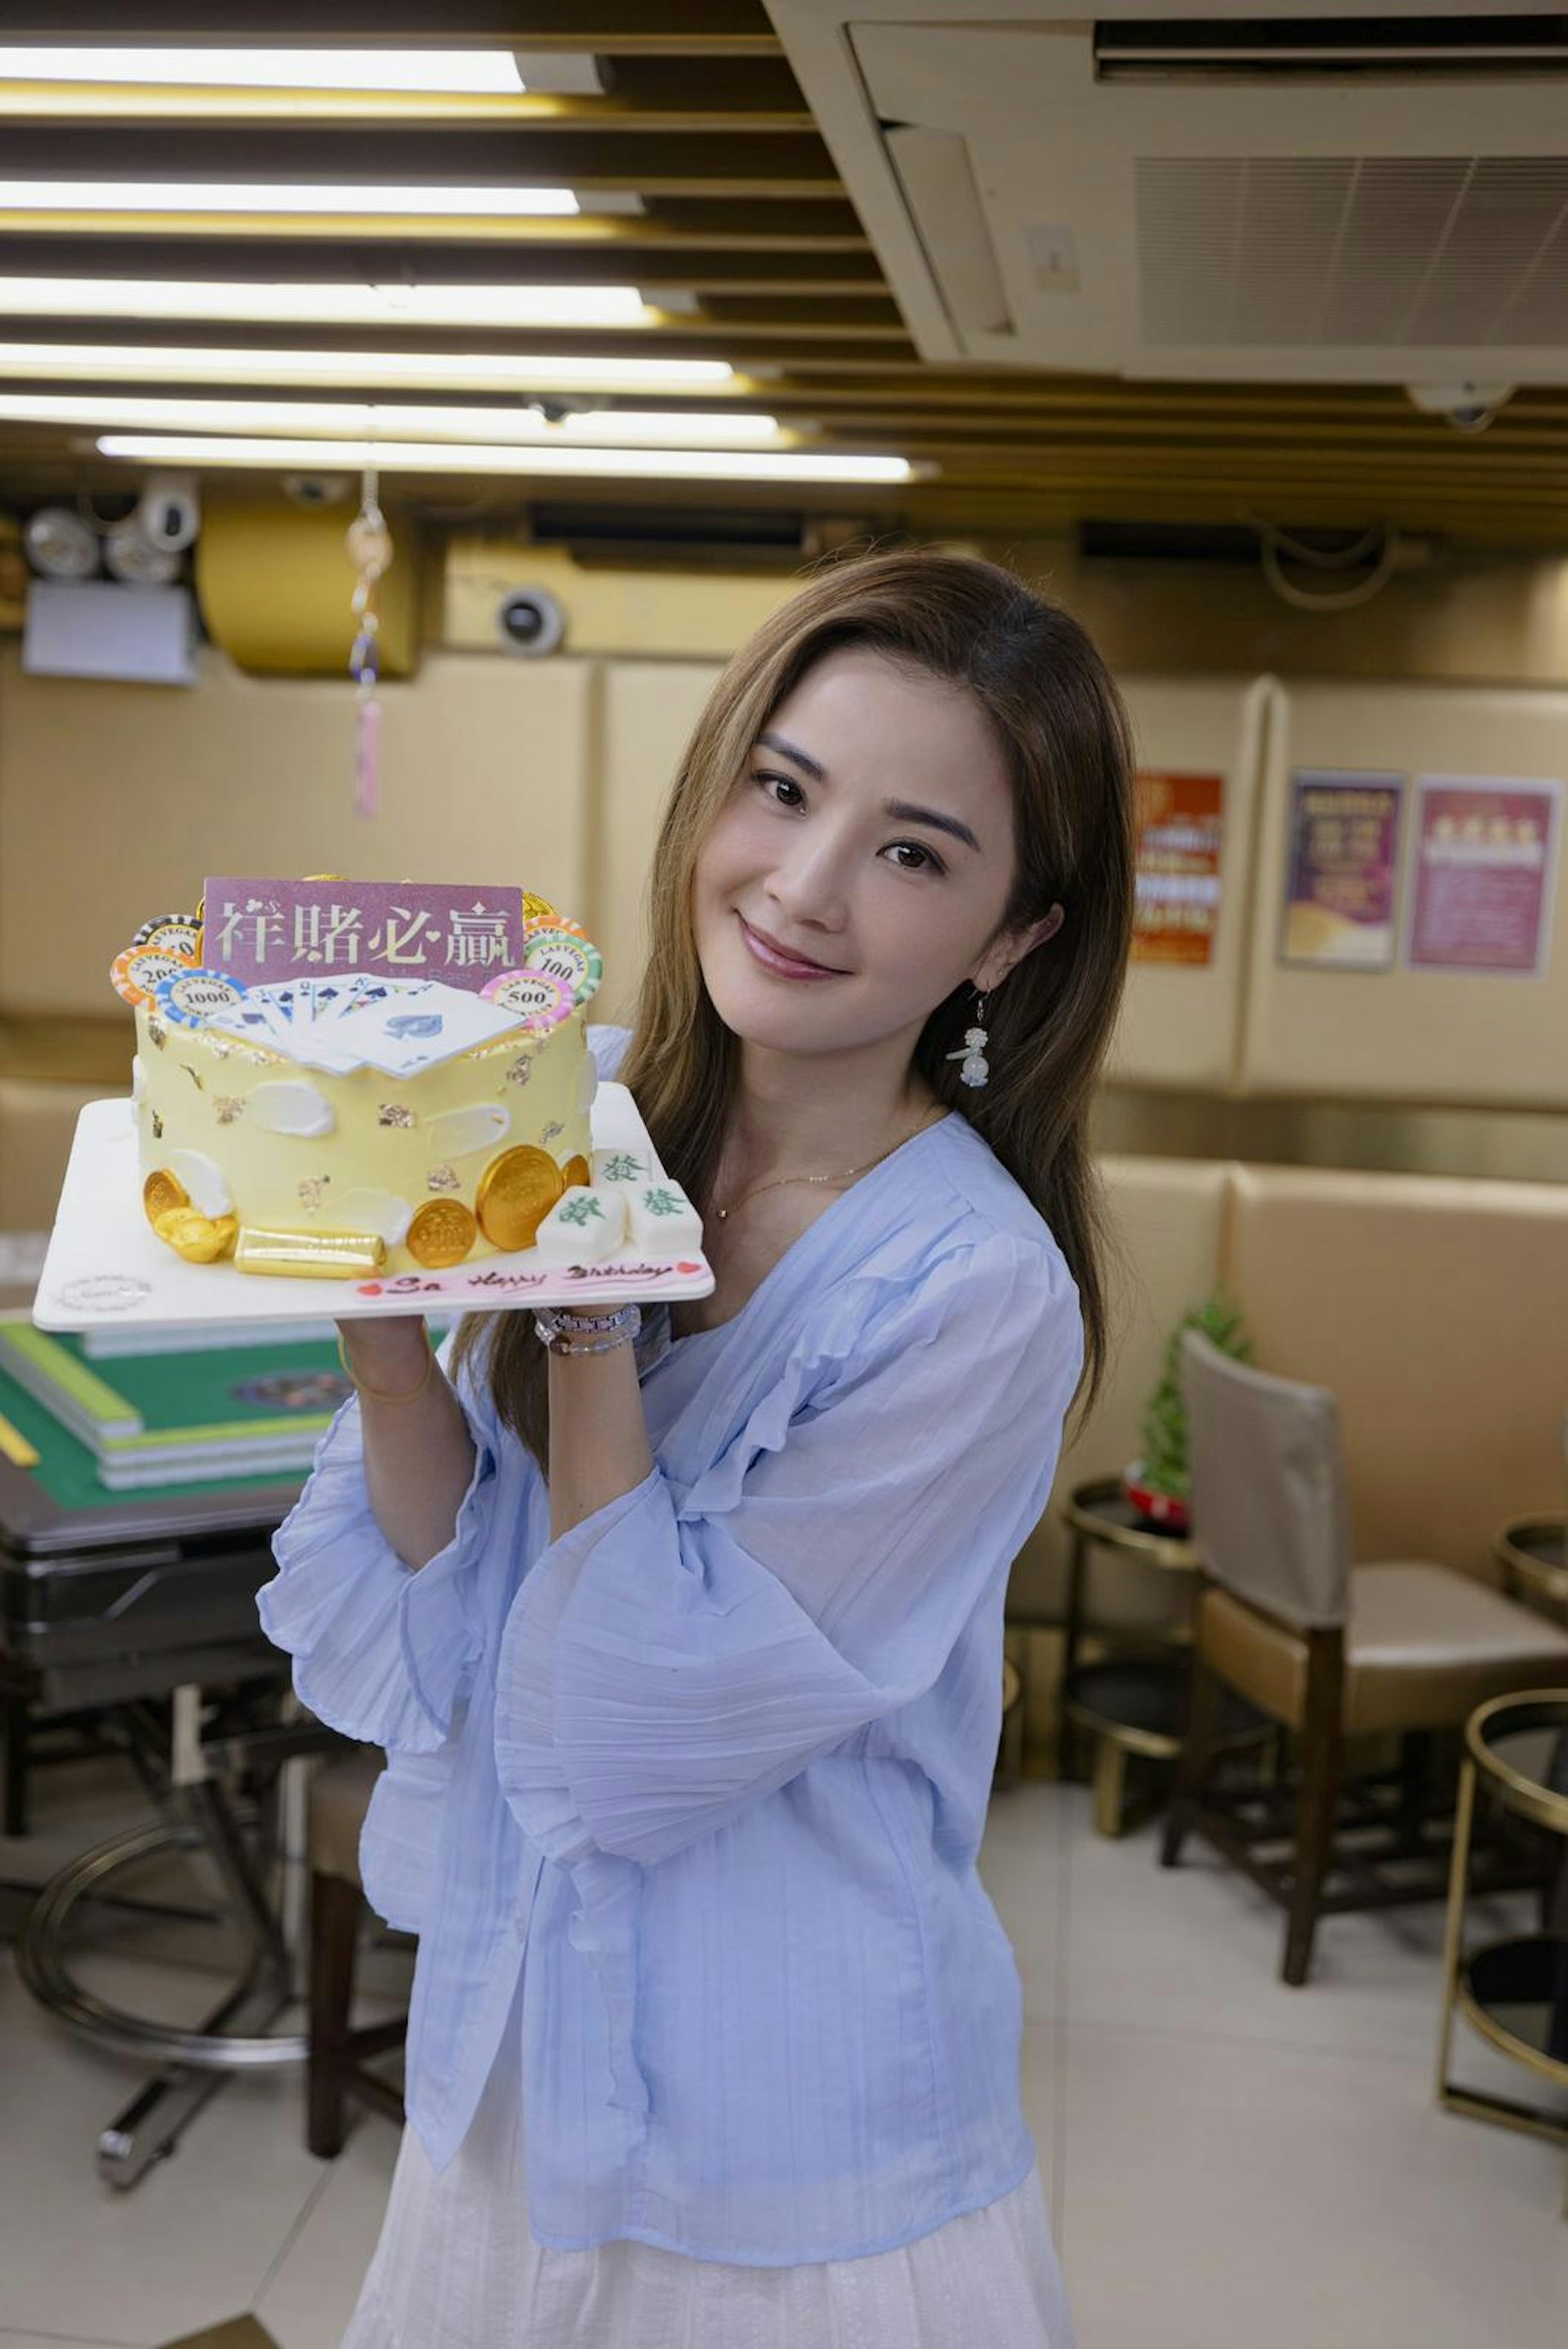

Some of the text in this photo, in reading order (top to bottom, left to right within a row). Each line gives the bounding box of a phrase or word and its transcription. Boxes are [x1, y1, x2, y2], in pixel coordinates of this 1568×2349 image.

[541, 958, 574, 981] 100
[185, 992, 230, 1005] 1000
[507, 991, 546, 1004] 500
